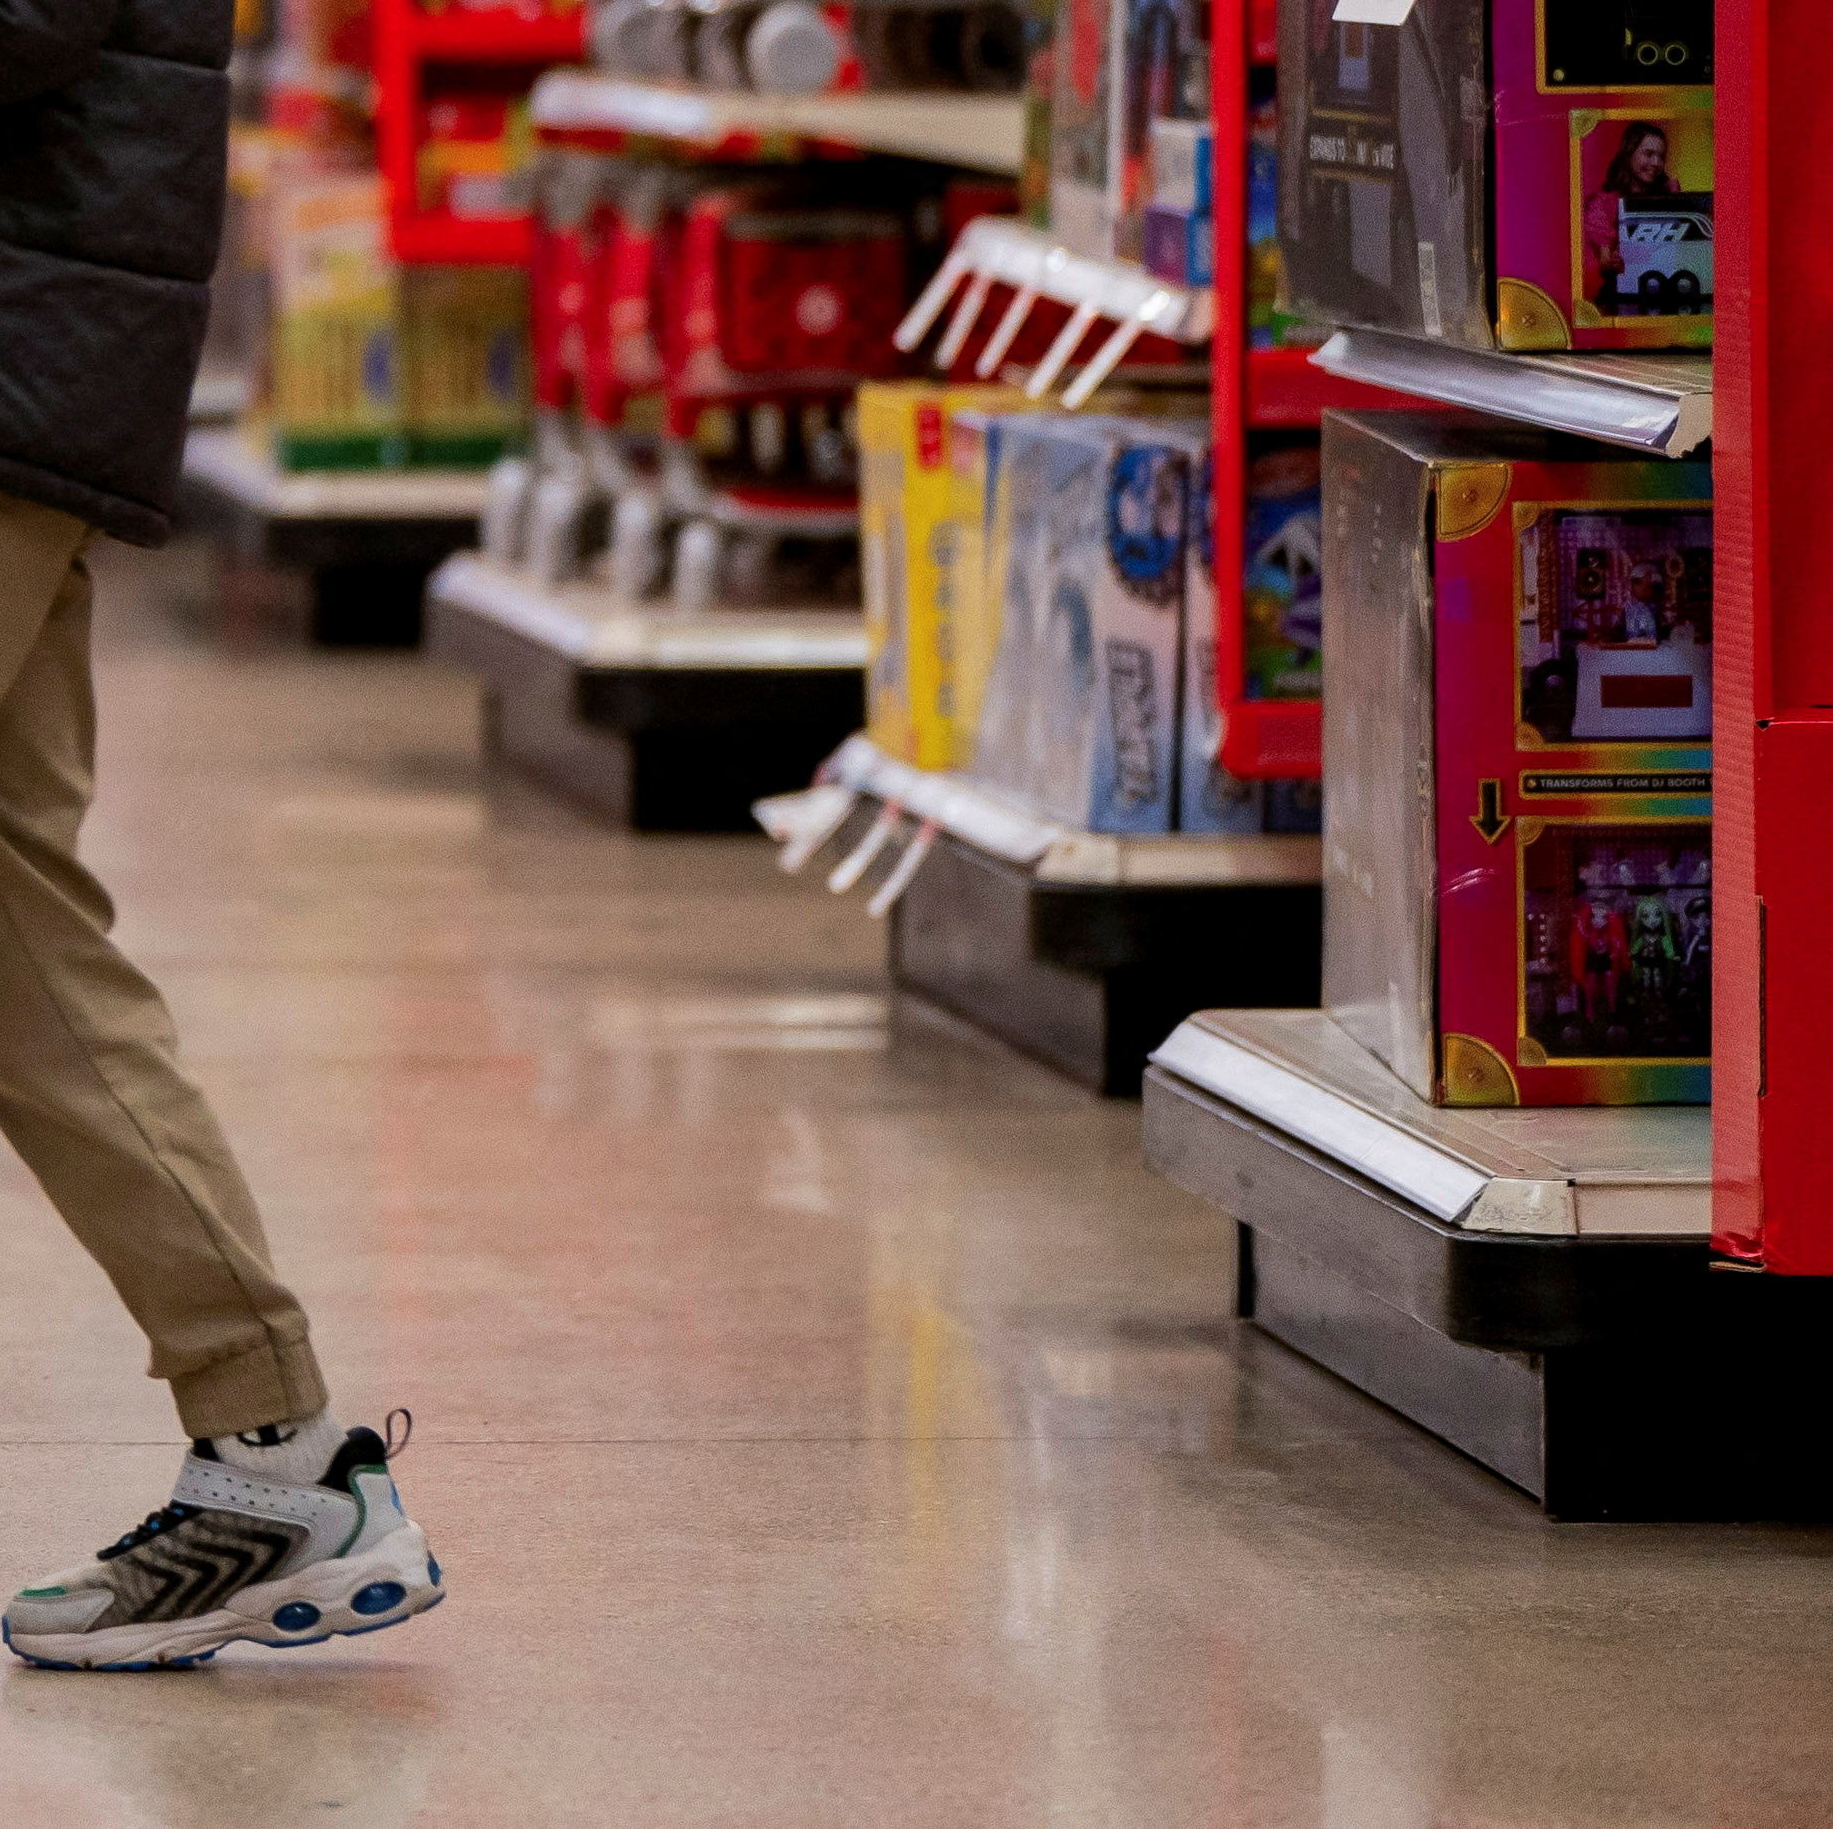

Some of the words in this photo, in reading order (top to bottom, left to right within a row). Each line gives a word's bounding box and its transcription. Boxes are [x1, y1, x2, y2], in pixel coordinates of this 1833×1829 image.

[1540, 778, 1614, 788] TRANSFORMS
[1616, 778, 1649, 787] FROM
[1667, 777, 1706, 787] BOOTH
